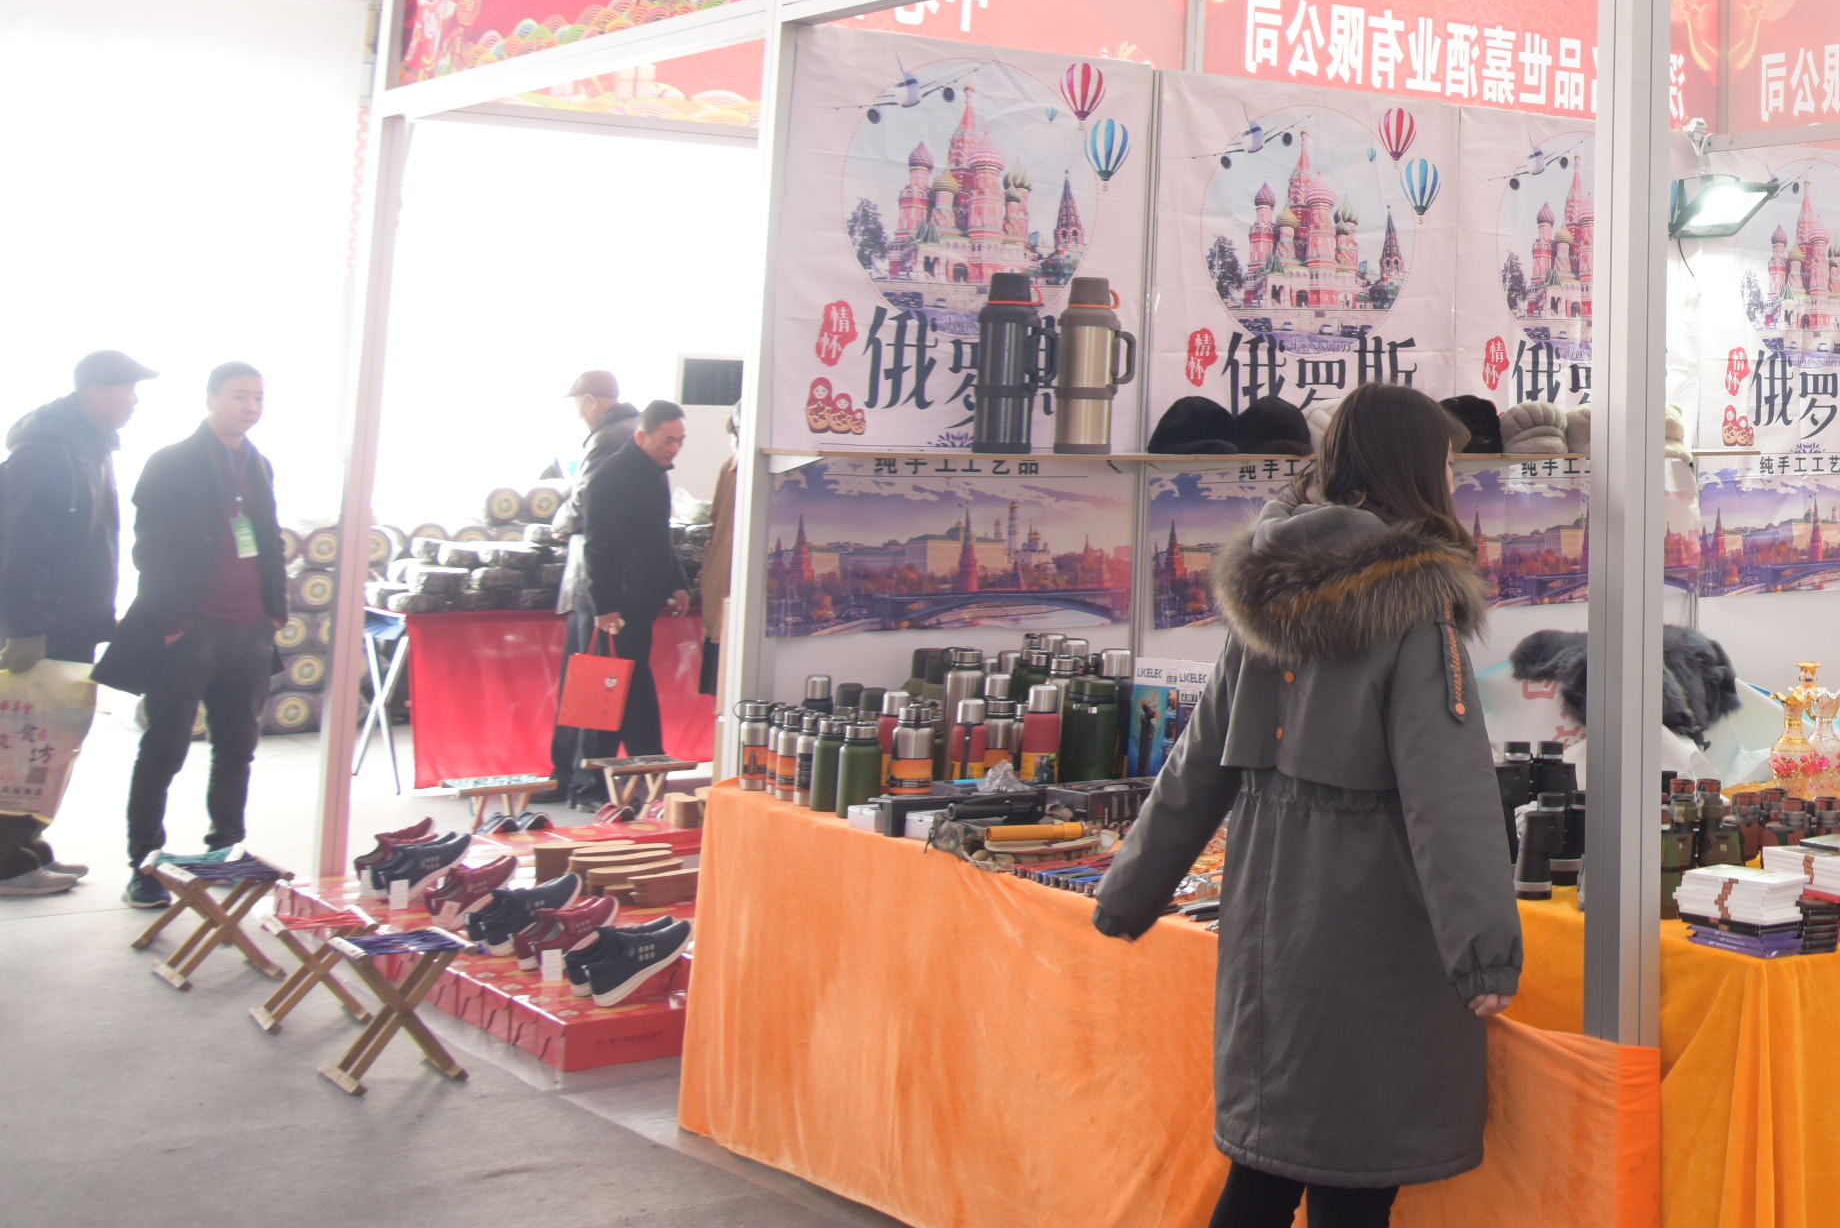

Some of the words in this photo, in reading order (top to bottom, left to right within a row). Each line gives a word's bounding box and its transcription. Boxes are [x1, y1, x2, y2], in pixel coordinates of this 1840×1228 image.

[819, 304, 851, 361] 情怀
[1186, 333, 1214, 383] 情怀
[1483, 340, 1506, 386] 情怀
[1725, 349, 1747, 393] 情怀
